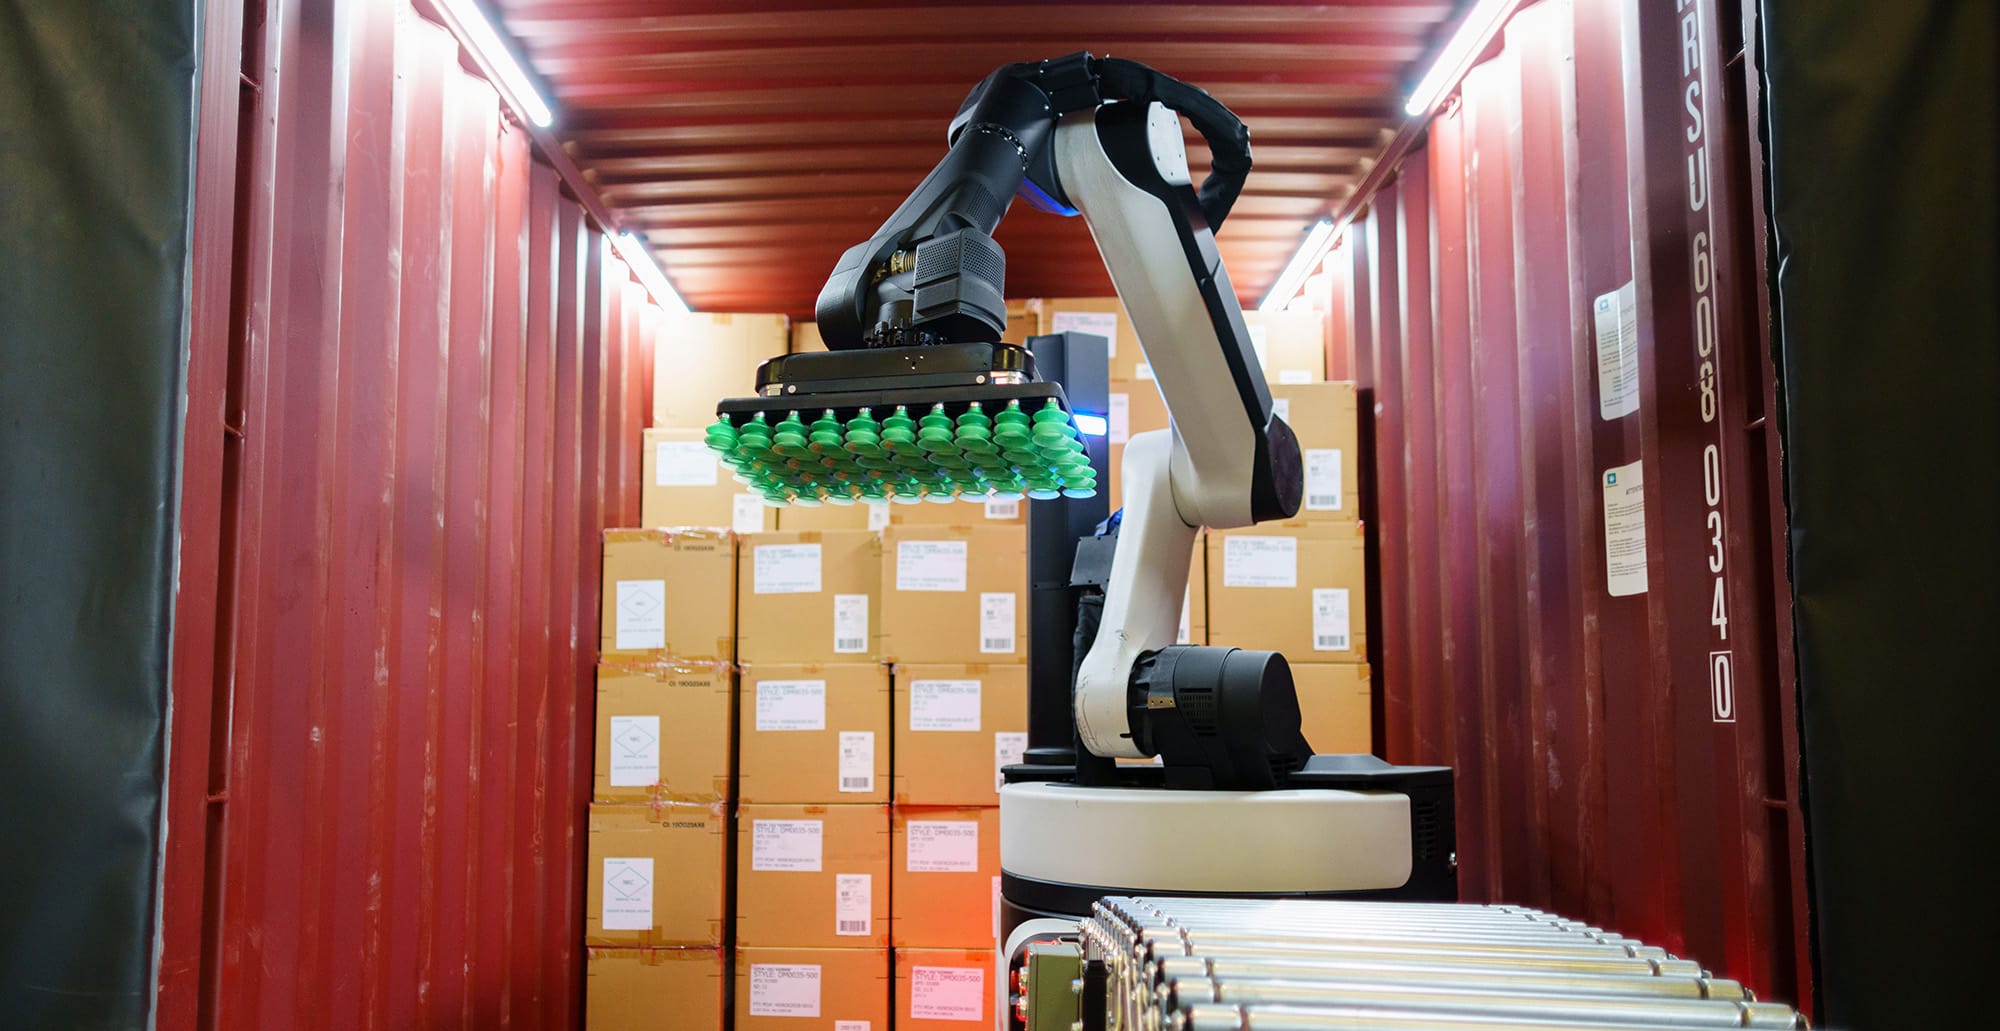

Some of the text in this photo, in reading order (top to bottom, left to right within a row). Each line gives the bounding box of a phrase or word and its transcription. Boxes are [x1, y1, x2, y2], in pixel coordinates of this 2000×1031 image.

[1676, 0, 1731, 719] RSU 608 034 0
